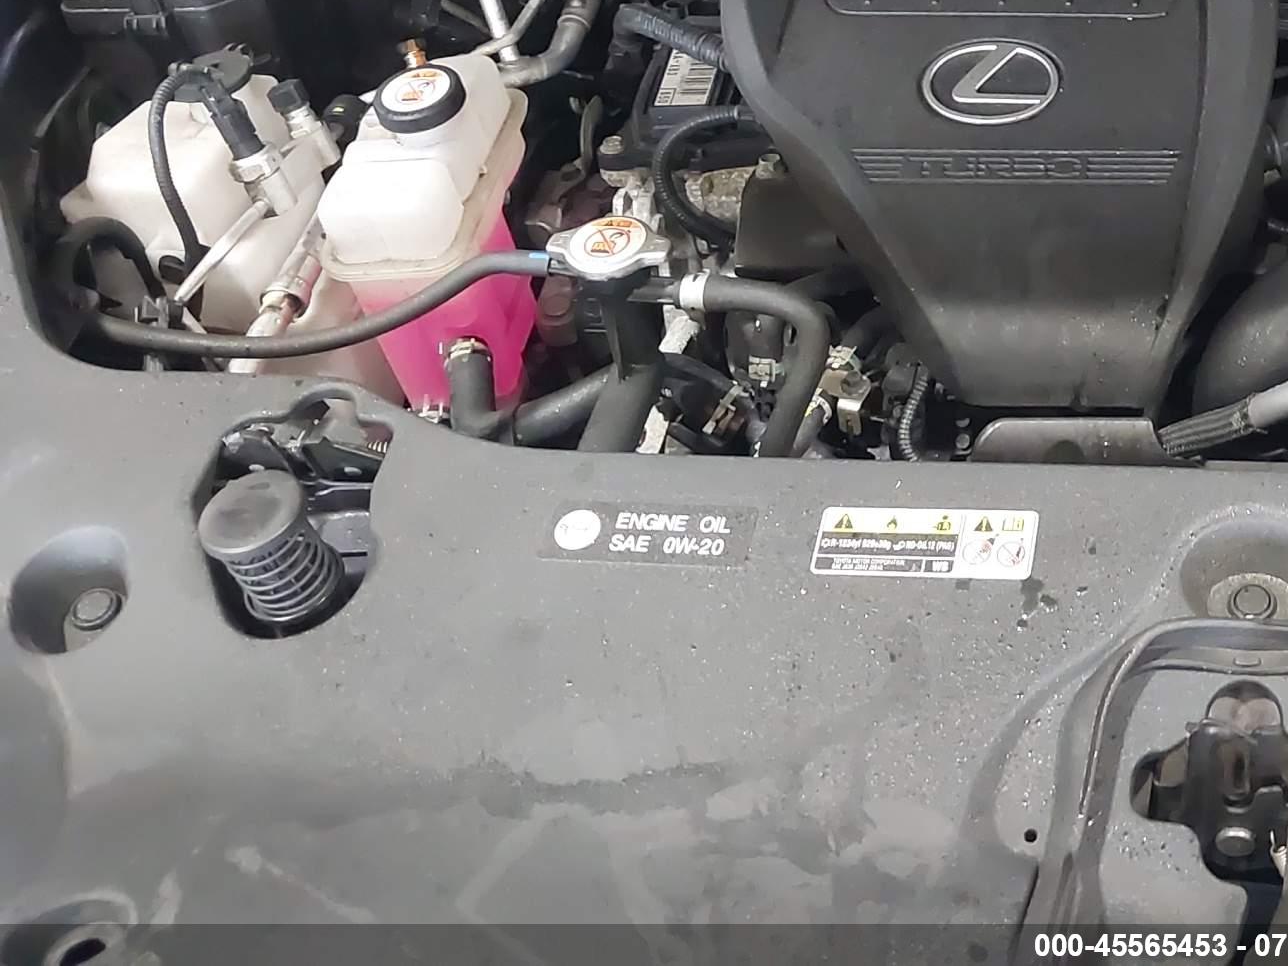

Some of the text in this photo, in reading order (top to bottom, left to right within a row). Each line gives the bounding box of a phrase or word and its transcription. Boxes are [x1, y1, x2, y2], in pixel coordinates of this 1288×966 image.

[907, 156, 1083, 179] TURBO
[615, 512, 731, 534] ENGINE OIL
[609, 535, 725, 556] SAE 0W-20
